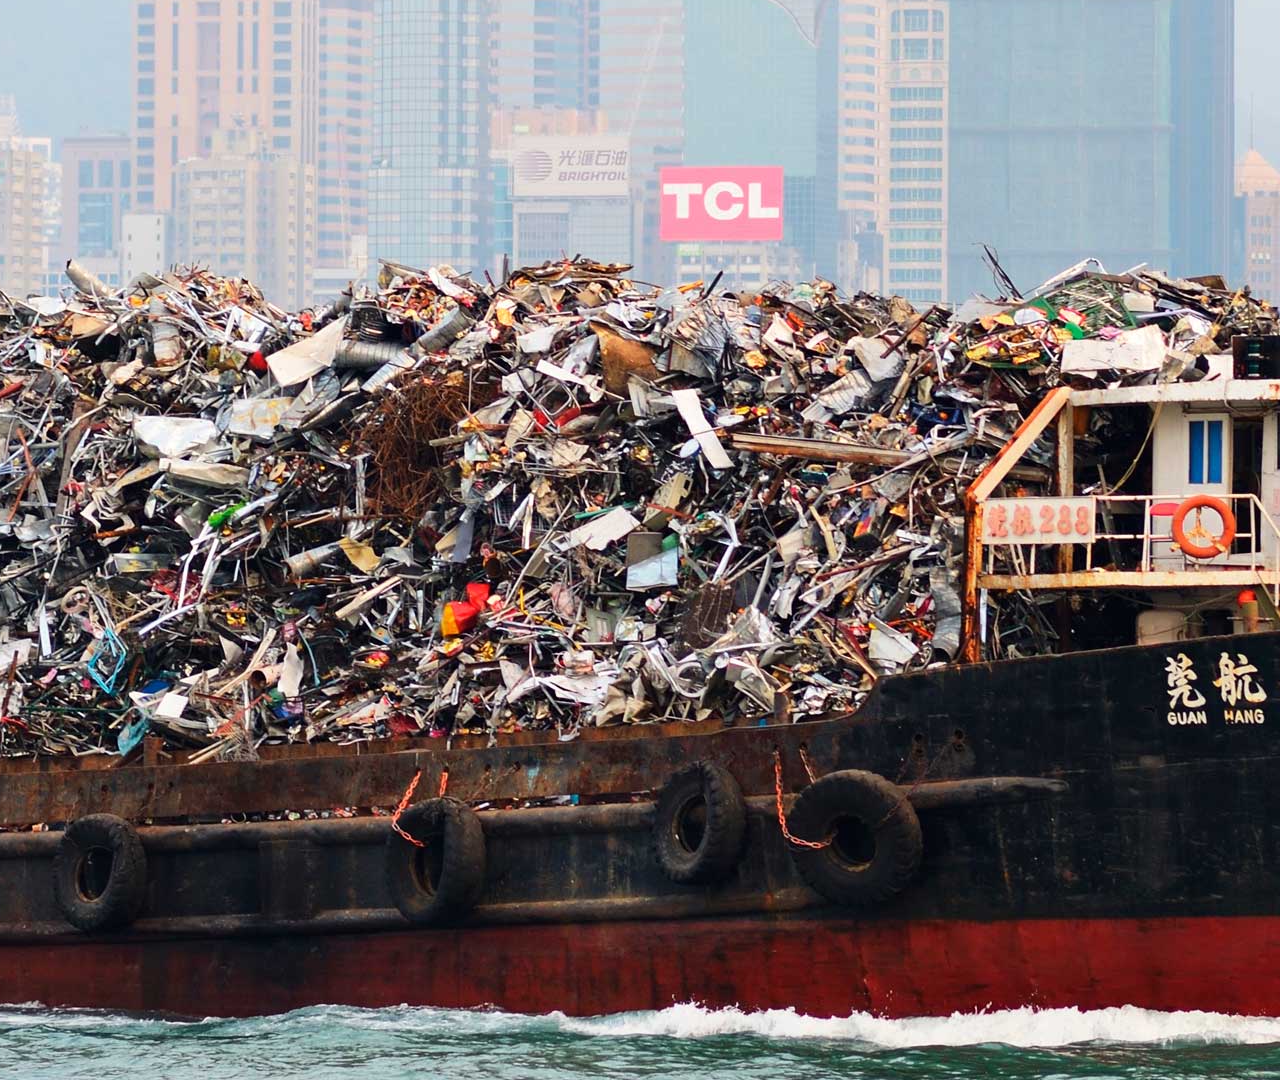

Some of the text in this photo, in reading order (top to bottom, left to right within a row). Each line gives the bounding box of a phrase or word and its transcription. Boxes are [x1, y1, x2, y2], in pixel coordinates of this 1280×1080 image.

[663, 181, 780, 221] TCL
[1167, 708, 1265, 726] GUAN HANG
